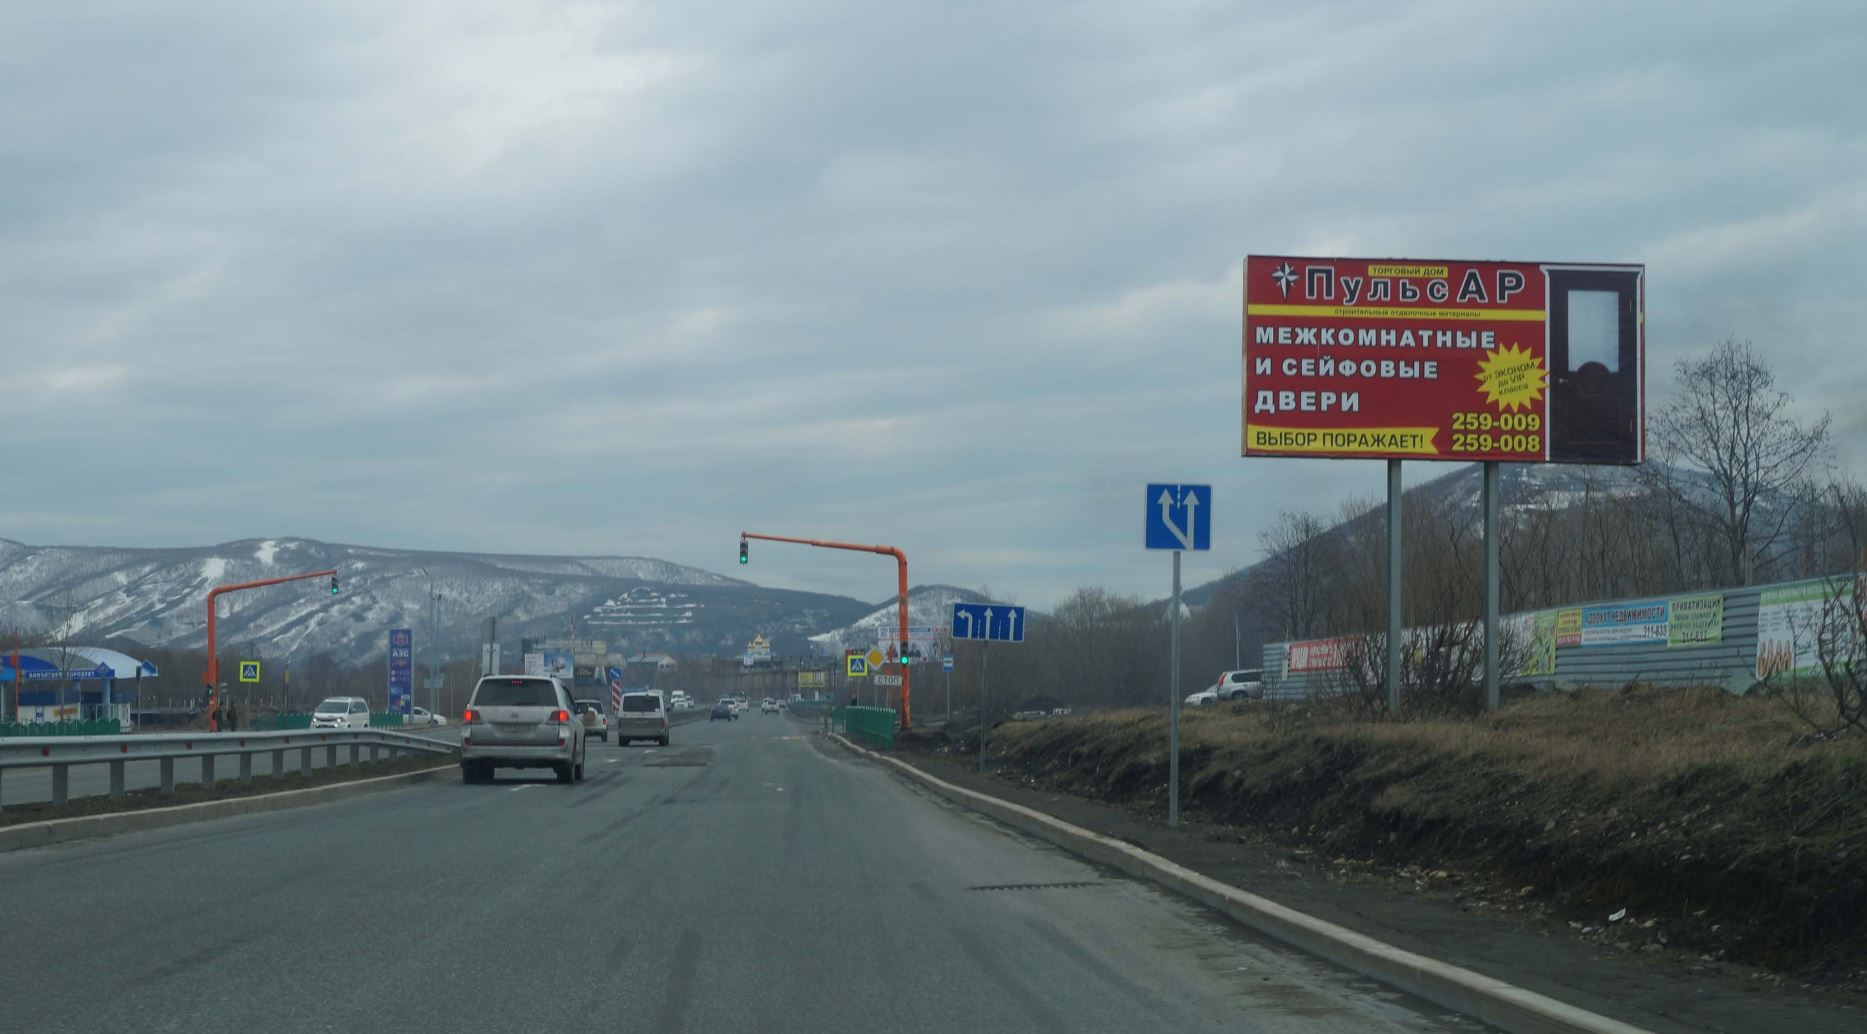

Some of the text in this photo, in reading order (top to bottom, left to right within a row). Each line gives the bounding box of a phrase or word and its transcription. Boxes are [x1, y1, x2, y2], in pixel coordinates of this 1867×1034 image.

[1373, 266, 1444, 277] ТОРГОВЫЙ ДОМ
[1305, 265, 1525, 305] ПульсАР
[1255, 326, 1495, 349] МЕЖКОМНАТНЫЕ
[1255, 355, 1438, 379] И СЕЙФОВЫЕ
[1495, 362, 1536, 379] ЭКОНОМ
[1510, 373, 1525, 383] VIP
[1254, 390, 1360, 415] ДВЕРИ
[1452, 412, 1540, 432] 259-009
[1256, 430, 1424, 449] ВЫБОР ПОРАЖАЕТ!
[1451, 432, 1540, 453] 259-008
[878, 676, 899, 685] СТОП
